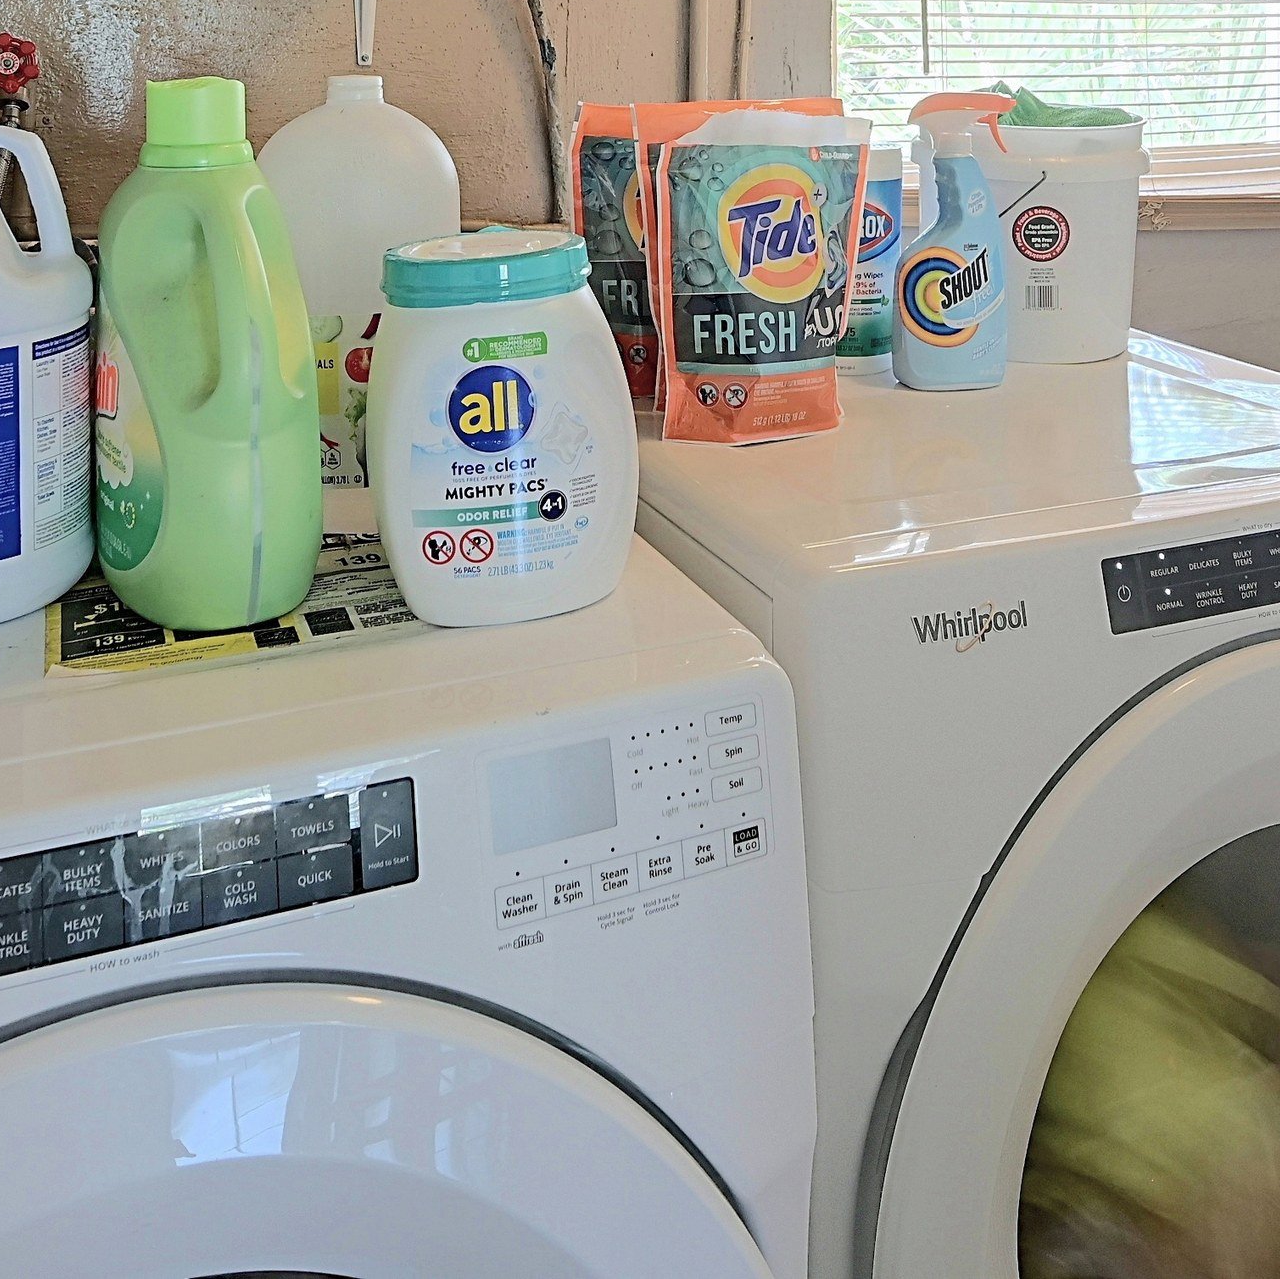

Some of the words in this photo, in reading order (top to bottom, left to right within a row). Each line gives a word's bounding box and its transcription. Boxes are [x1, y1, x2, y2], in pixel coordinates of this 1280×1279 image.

[728, 197, 817, 278] Tide
[939, 247, 987, 310] SHOUT
[602, 279, 649, 317] FR
[693, 310, 796, 355] FRESH
[459, 379, 519, 435] all
[452, 461, 485, 476] free
[495, 457, 537, 473] clear
[445, 484, 505, 500] MIGHTY
[457, 510, 491, 522] ODOR
[492, 507, 528, 520] RELIEF
[335, 553, 381, 566] 139
[1233, 550, 1252, 559] BULKY
[463, 565, 481, 573] PACS
[1188, 559, 1220, 571] DELICATES
[1234, 558, 1253, 567] ITEMS
[1150, 566, 1179, 578] REGULAR
[1195, 588, 1222, 599] WRINKLE
[1238, 582, 1258, 591] HEAVY
[1196, 596, 1225, 608] CONTROL
[1241, 590, 1257, 599] DUTY
[1156, 600, 1184, 611] NORMAL
[913, 600, 1027, 643] Whirlpool
[95, 635, 125, 647] 139
[719, 714, 742, 725] Temp
[627, 748, 643, 759] Cold
[725, 746, 743, 758] Spin
[729, 777, 744, 789] Soil
[688, 799, 709, 809] Heavy
[290, 820, 335, 839] TOWELS
[735, 828, 756, 841] LOAD
[216, 834, 261, 853] COLORS
[696, 843, 712, 855] Pre
[746, 841, 757, 850] GO
[139, 850, 184, 869] WHITES
[368, 860, 384, 870] Hold
[385, 858, 392, 867] to
[392, 855, 409, 865] Start
[648, 854, 672, 869] Extra
[694, 853, 715, 866] Soak
[62, 862, 103, 881] BULKY
[297, 869, 333, 887] QUICK
[600, 865, 629, 882] Steam
[648, 864, 673, 879] Rinse
[65, 875, 101, 893] ITEMS
[224, 880, 256, 896] COLD
[554, 879, 581, 894] Drain
[602, 877, 629, 892] Clean
[223, 892, 258, 909] WASH
[505, 892, 533, 907] Clean
[553, 896, 561, 906] &
[562, 889, 584, 905] Spin
[138, 900, 189, 923] SANITIZE
[502, 901, 539, 920] Washer
[644, 904, 666, 917] Control
[667, 901, 680, 911] Lock
[63, 913, 104, 933] HEAVY
[66, 927, 101, 945] DUTY
[498, 942, 512, 952] with
[89, 960, 116, 974] HOW
[119, 957, 130, 967] to
[133, 949, 160, 964] wash
